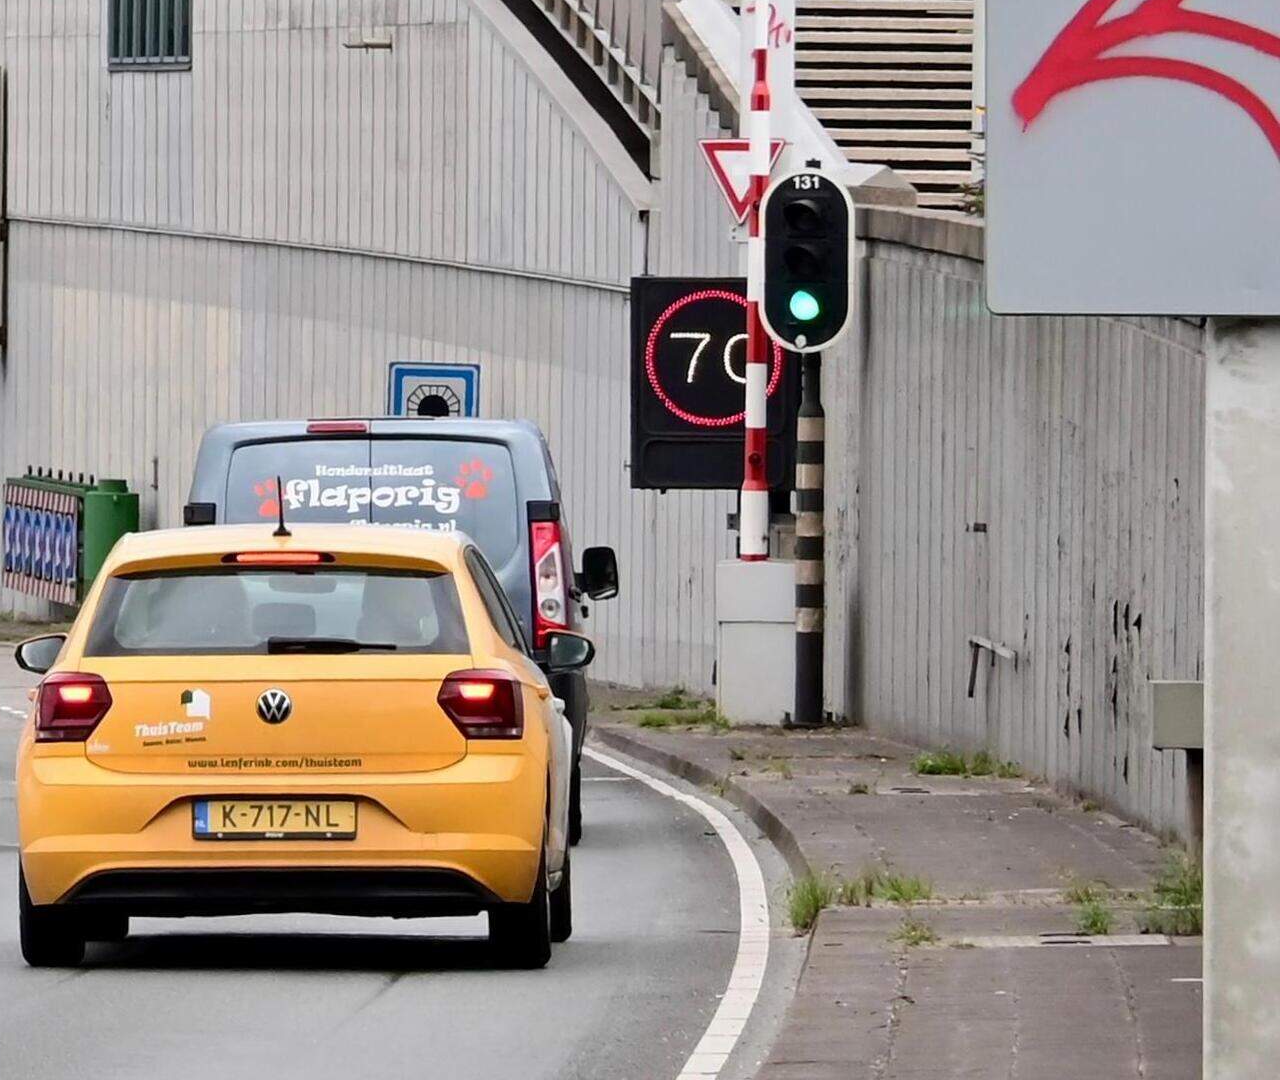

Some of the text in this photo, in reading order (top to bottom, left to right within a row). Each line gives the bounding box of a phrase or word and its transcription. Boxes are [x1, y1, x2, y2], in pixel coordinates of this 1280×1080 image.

[792, 175, 820, 190] 131
[283, 478, 461, 514] flaporig
[134, 721, 204, 738] ThuisTeam
[187, 757, 363, 770] www.lenferink.com/thuisteam
[222, 804, 340, 828] K-717-NL
